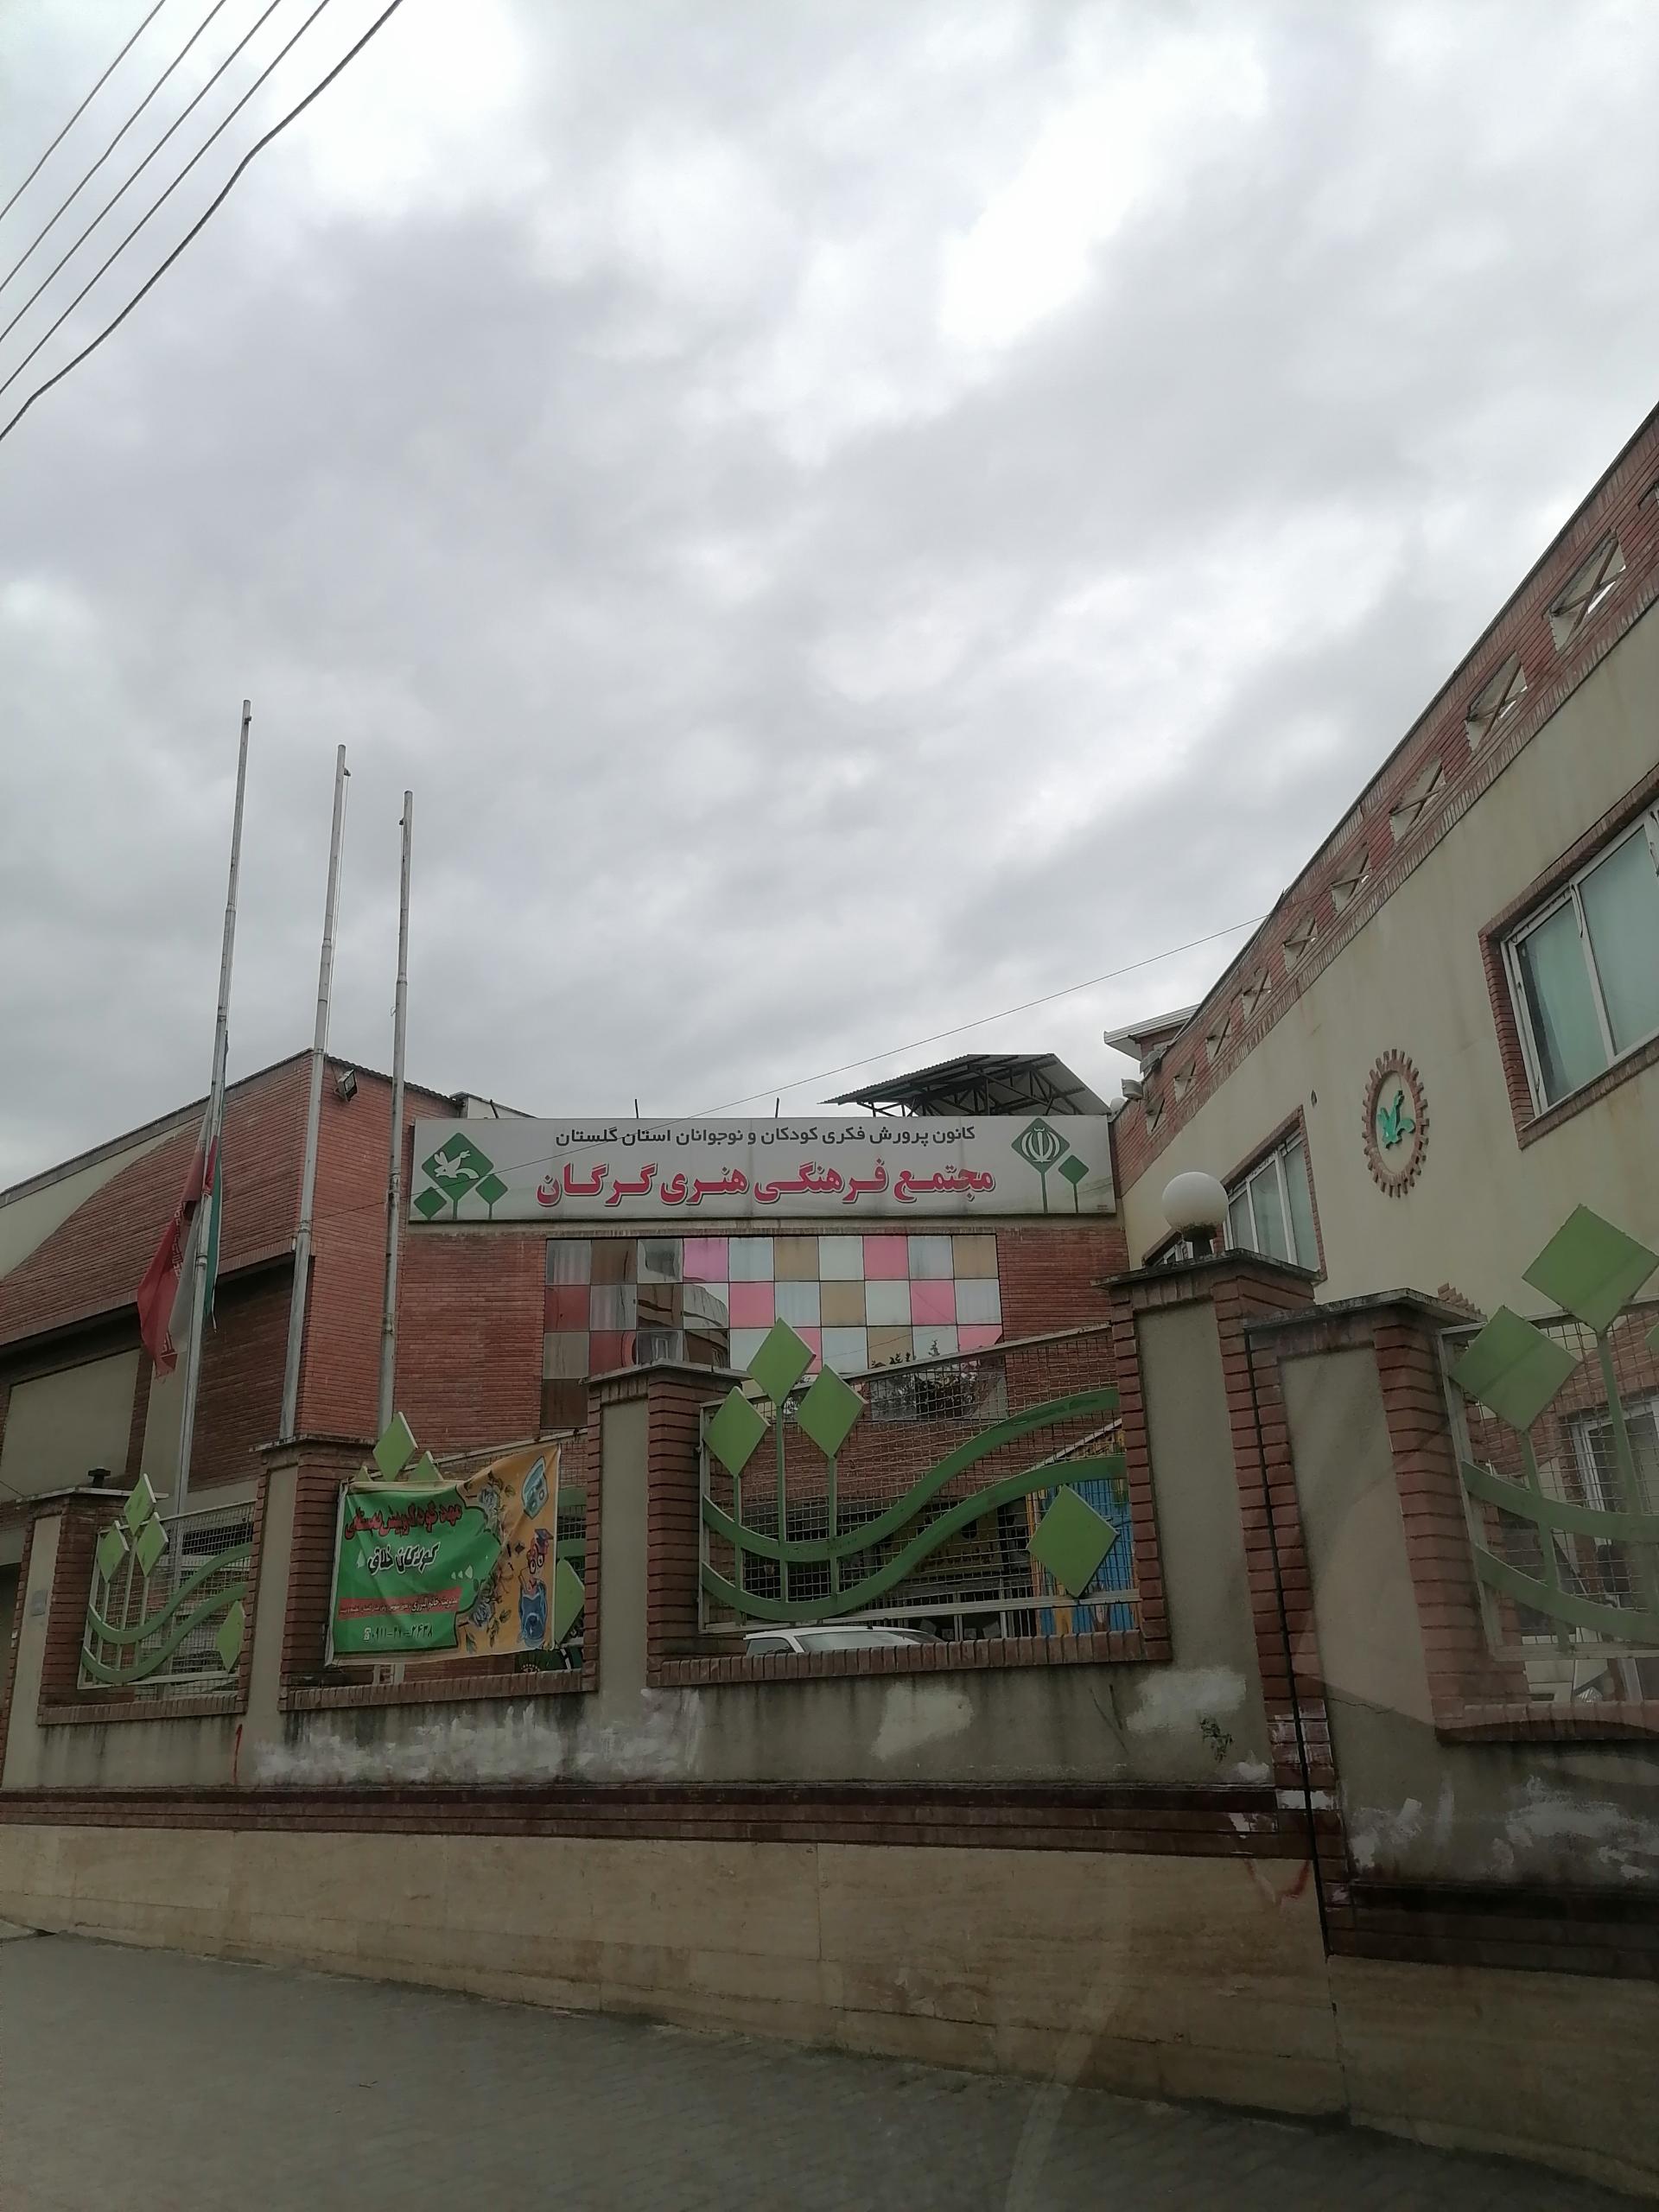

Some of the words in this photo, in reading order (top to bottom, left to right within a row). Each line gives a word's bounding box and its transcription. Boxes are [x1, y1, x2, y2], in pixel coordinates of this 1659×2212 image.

[556, 1126, 618, 1147] گلستان
[621, 1128, 671, 1147] استان
[676, 1128, 743, 1146] نوجوانان
[747, 1131, 756, 1146] و
[760, 1126, 818, 1145] کودکان
[822, 1126, 865, 1145] فکری
[869, 1126, 929, 1147] پرورش
[932, 1126, 976, 1145] کانون
[537, 1162, 658, 1206] گرگان
[660, 1166, 749, 1206] هنری
[753, 1158, 889, 1205] فرهنگی
[893, 1164, 995, 1204] مجتمع
[439, 1503, 463, 1527] مهد
[367, 1544, 395, 1575] خلاق
[395, 1541, 441, 1573] کودکان
